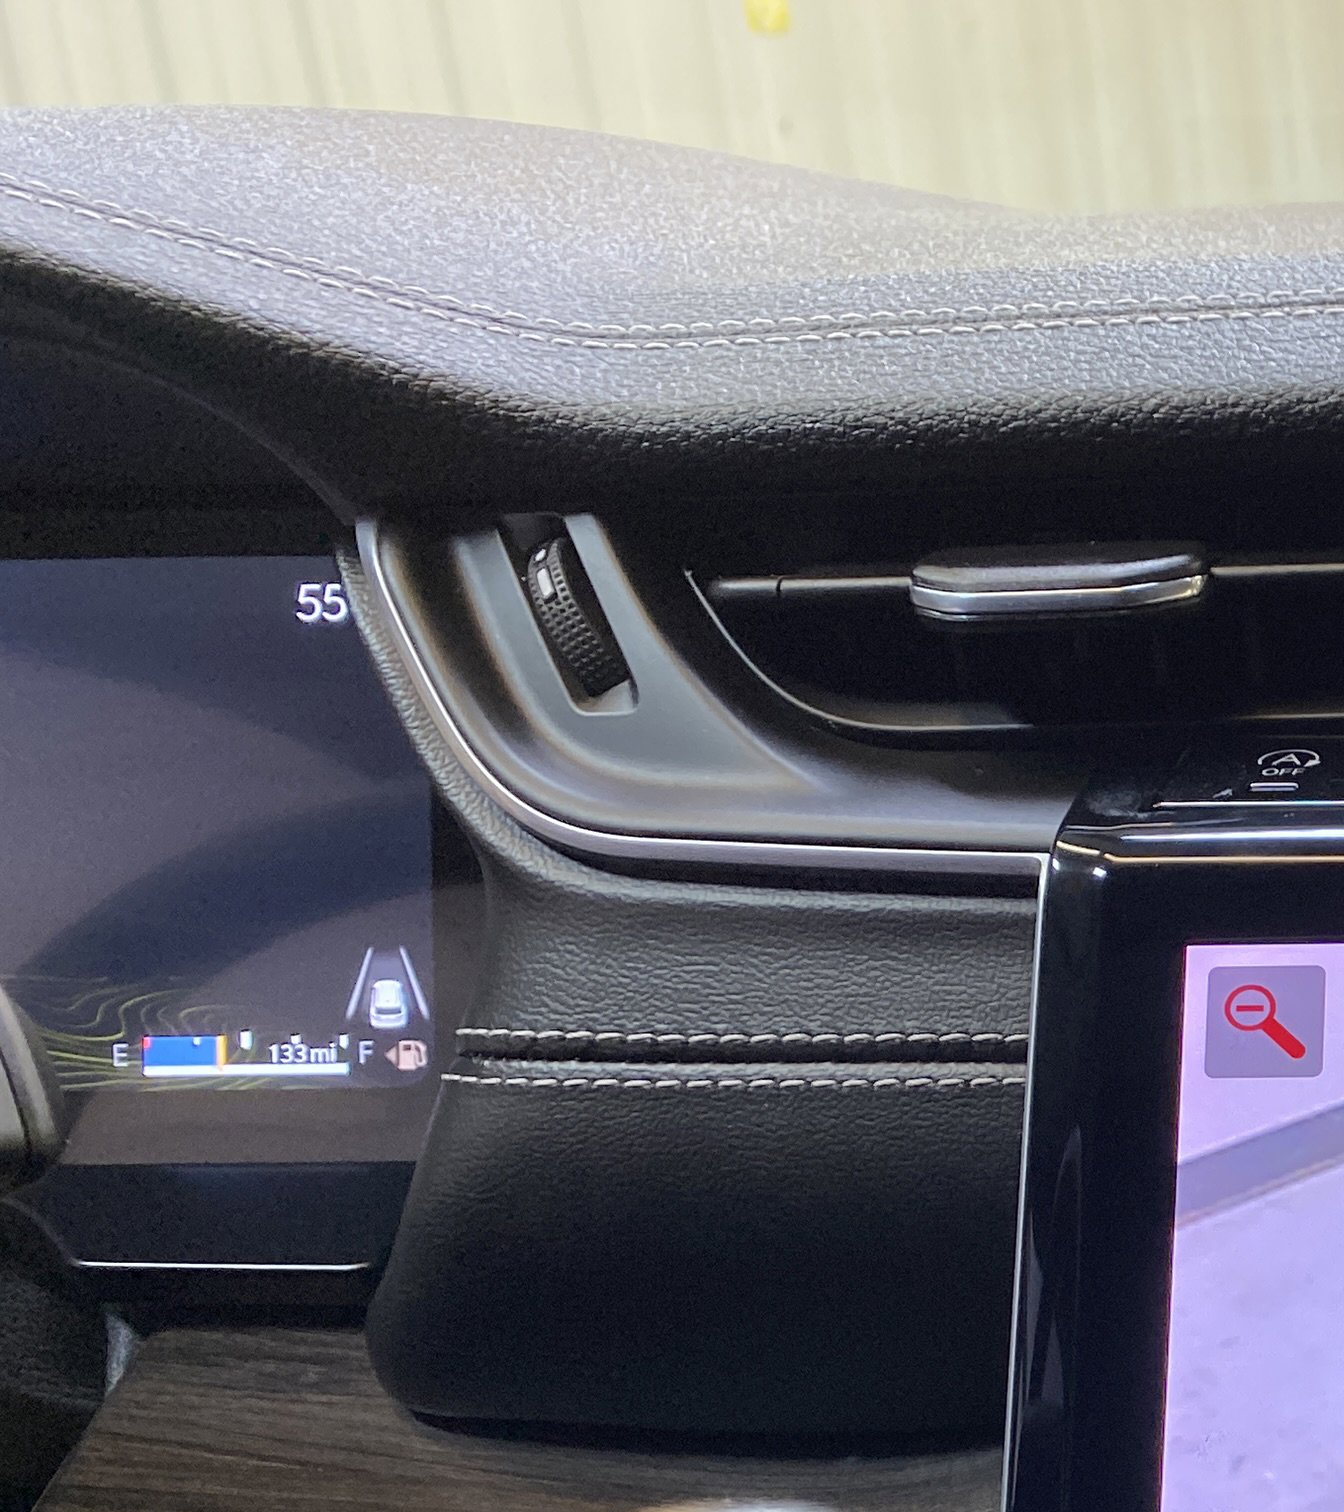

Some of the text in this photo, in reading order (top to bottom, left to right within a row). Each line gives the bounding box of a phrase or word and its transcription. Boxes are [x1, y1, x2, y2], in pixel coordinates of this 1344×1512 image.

[296, 583, 348, 623] 55
[1261, 767, 1306, 776] OFF
[111, 1042, 129, 1067] E
[358, 1040, 374, 1064] F
